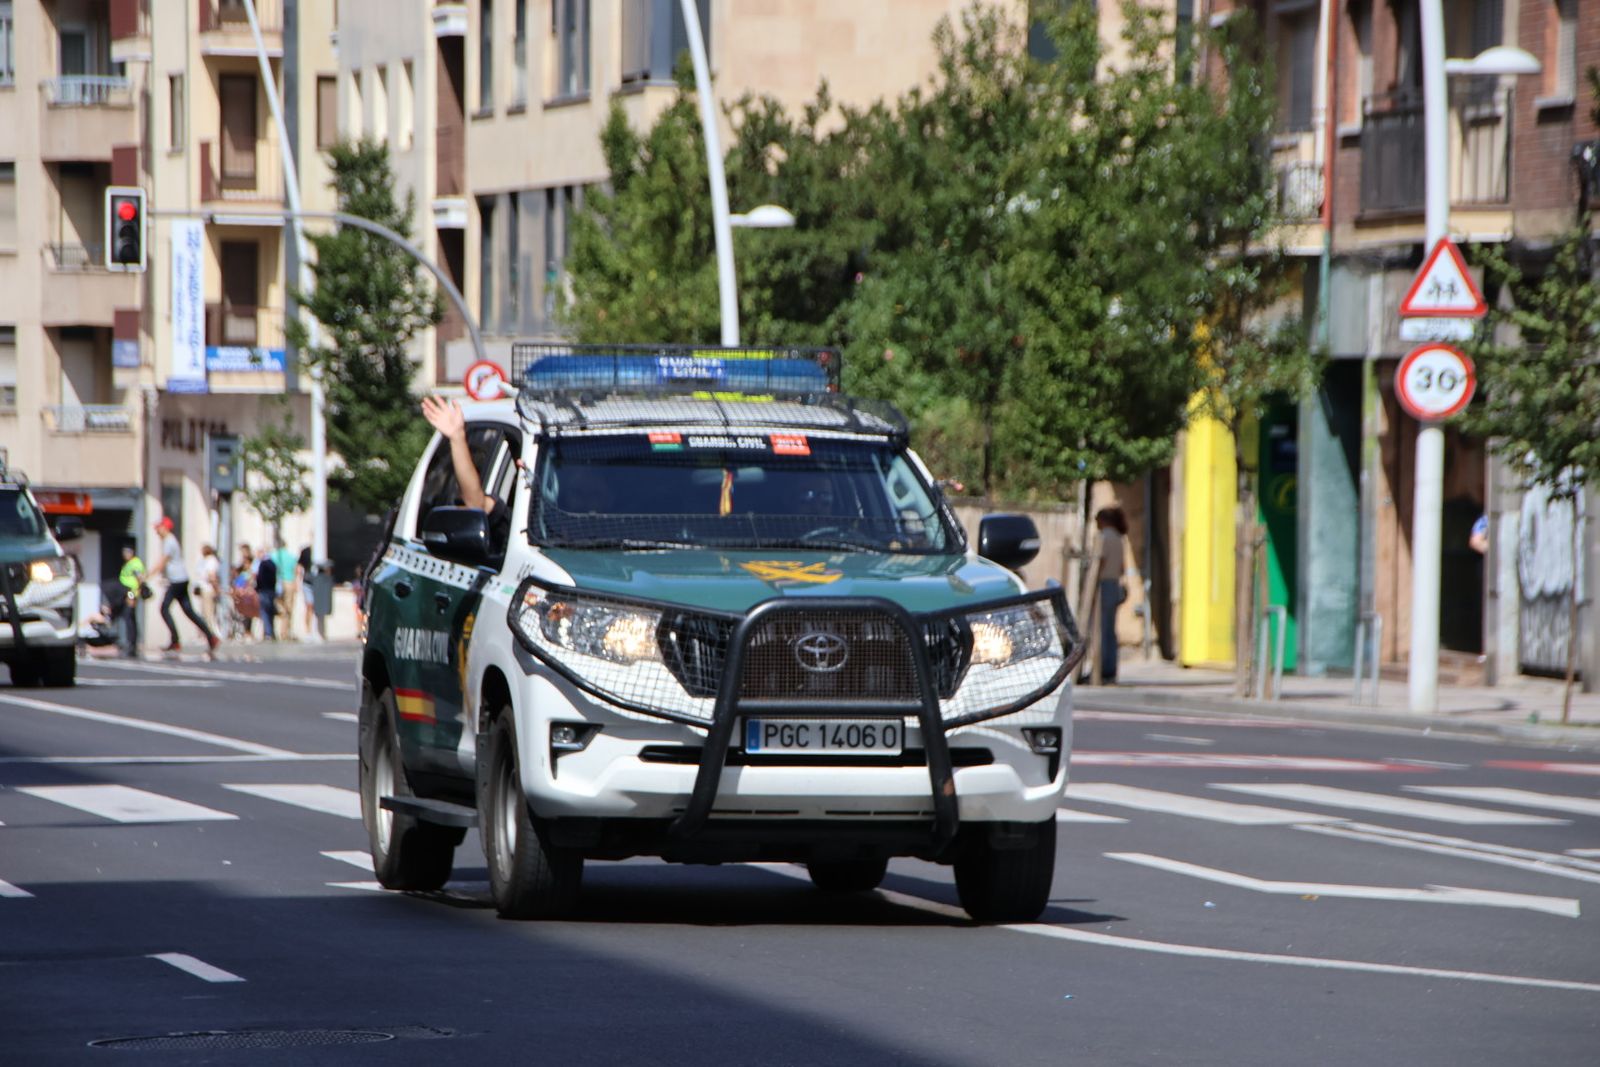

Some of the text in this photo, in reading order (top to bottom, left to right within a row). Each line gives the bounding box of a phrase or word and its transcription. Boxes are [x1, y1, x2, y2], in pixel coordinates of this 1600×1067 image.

[673, 367, 710, 377] CIVIL
[1416, 367, 1456, 392] 30
[689, 436, 736, 447] GUARDIA
[737, 437, 766, 449] CIVIL
[394, 626, 431, 661] GUARDIA
[765, 724, 809, 748] PGC
